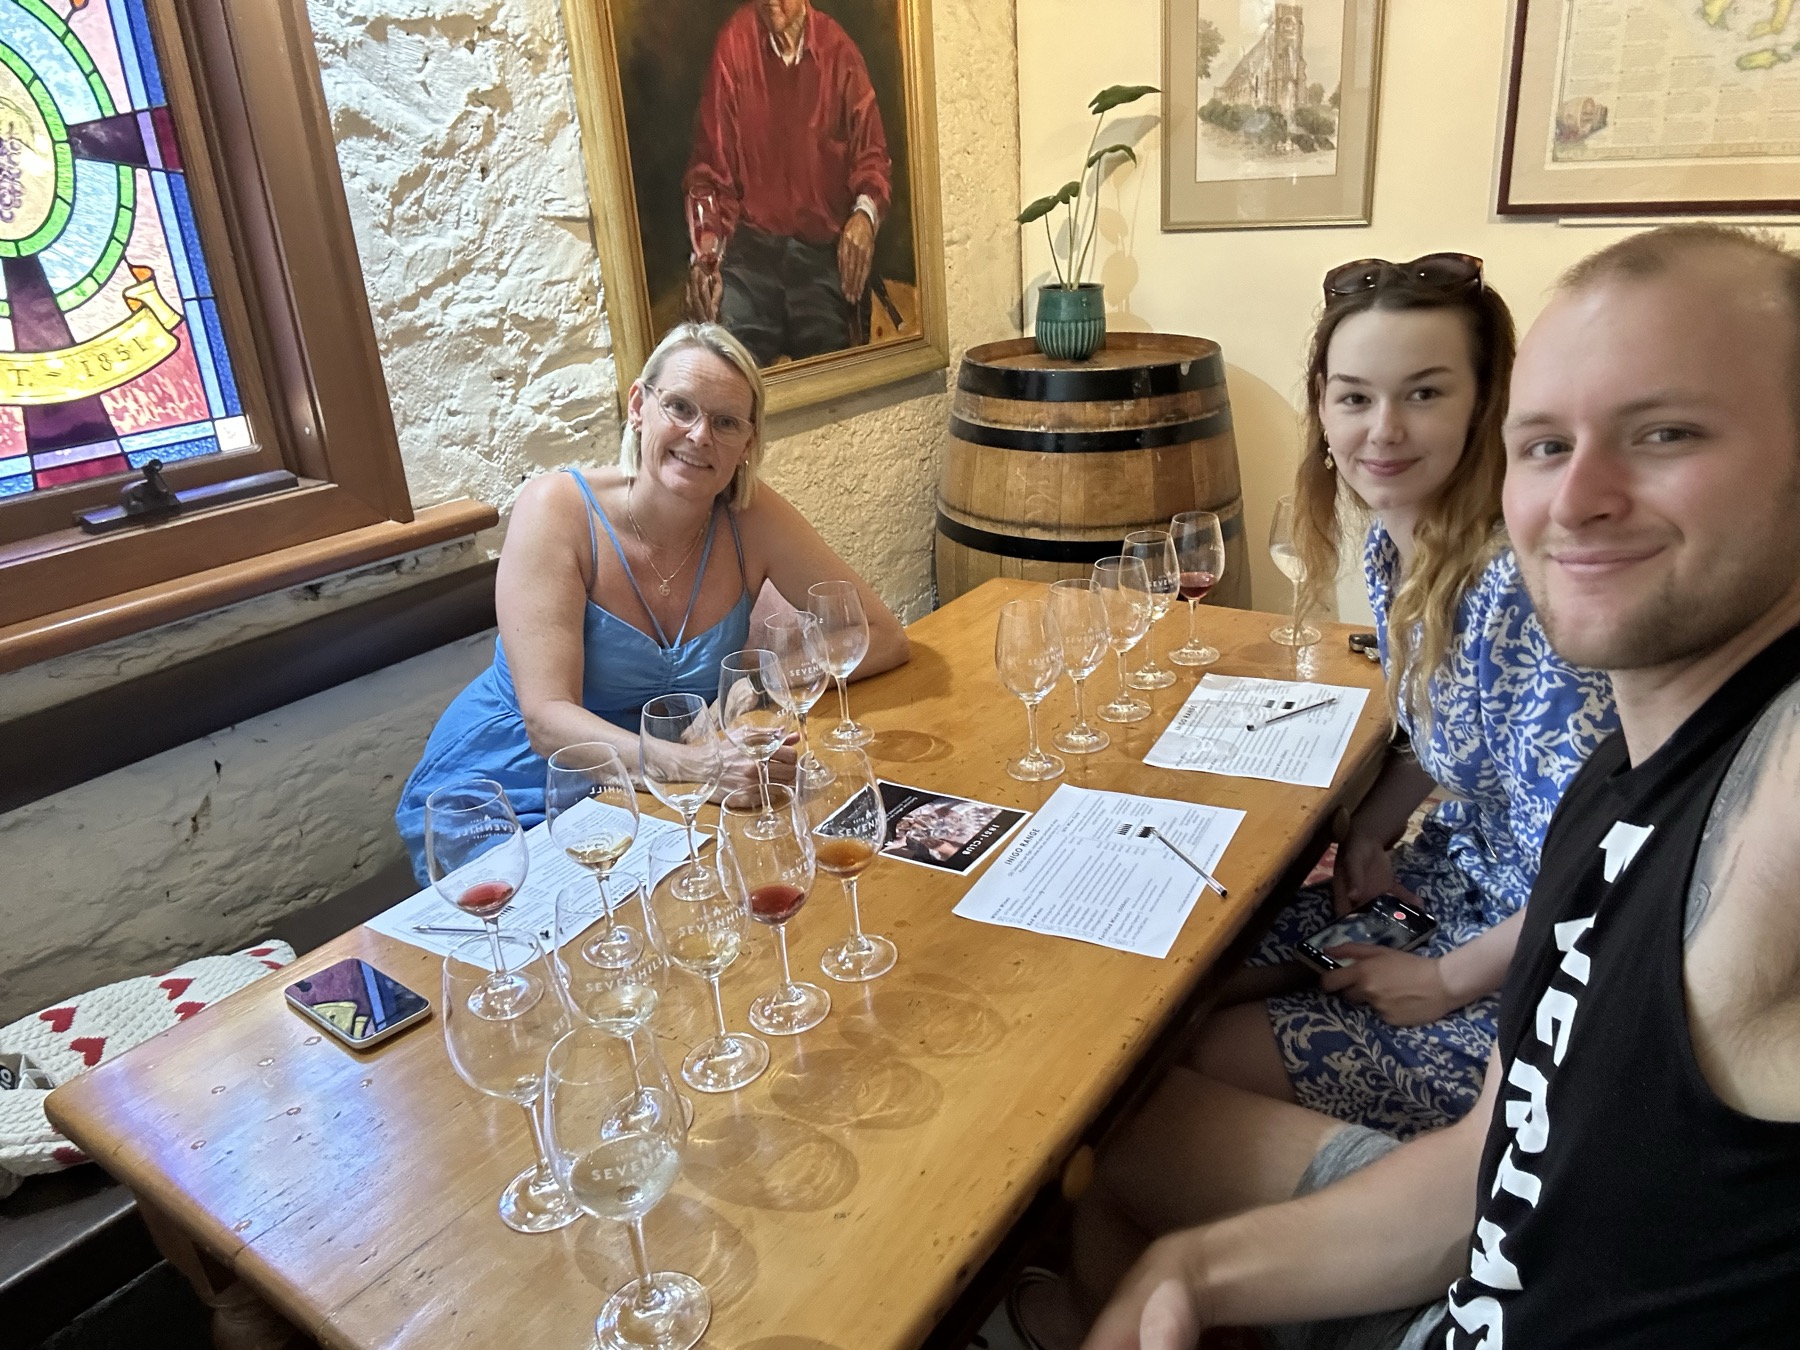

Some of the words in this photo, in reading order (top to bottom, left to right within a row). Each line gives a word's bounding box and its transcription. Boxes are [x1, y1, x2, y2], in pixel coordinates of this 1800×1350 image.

[80, 336, 149, 379] 1851
[1004, 847, 1024, 866] INIGO
[1020, 828, 1040, 848] RANGE
